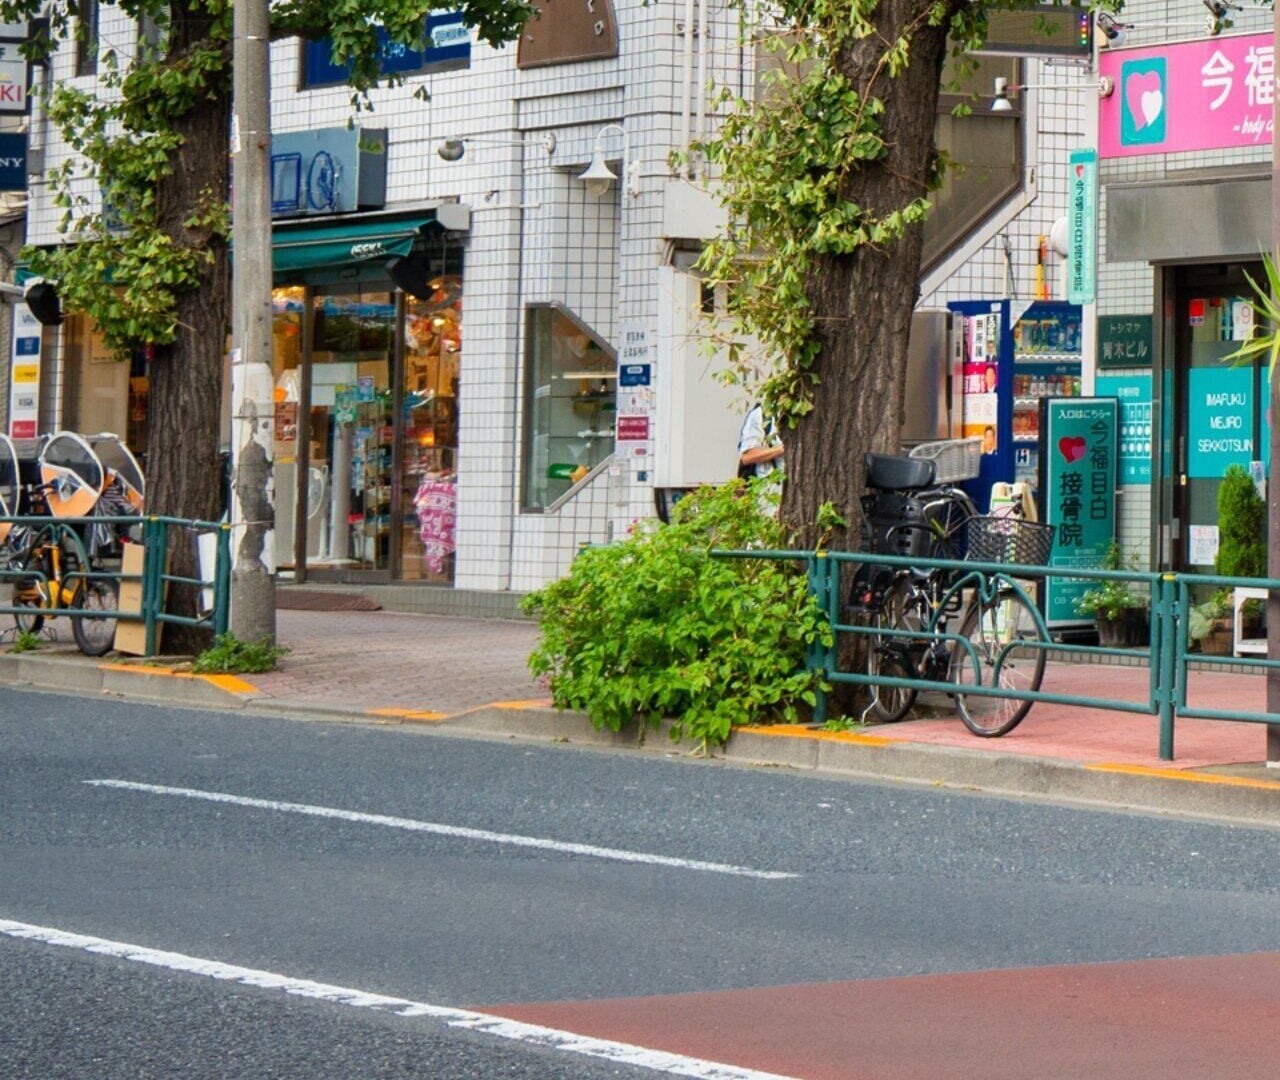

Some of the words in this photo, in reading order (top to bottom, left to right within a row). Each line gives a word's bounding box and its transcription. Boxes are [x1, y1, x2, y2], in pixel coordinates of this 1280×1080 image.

[1241, 114, 1264, 141] body
[1102, 341, 1148, 359] 青木ビル
[1206, 393, 1246, 406] IMAFUKU
[1058, 409, 1105, 419] 入口はこちら
[1210, 415, 1242, 429] MEJIRO
[1198, 439, 1254, 452] SEKKOTSUIN
[1090, 420, 1108, 520] 今福目白
[1059, 472, 1082, 547] 接骨院
